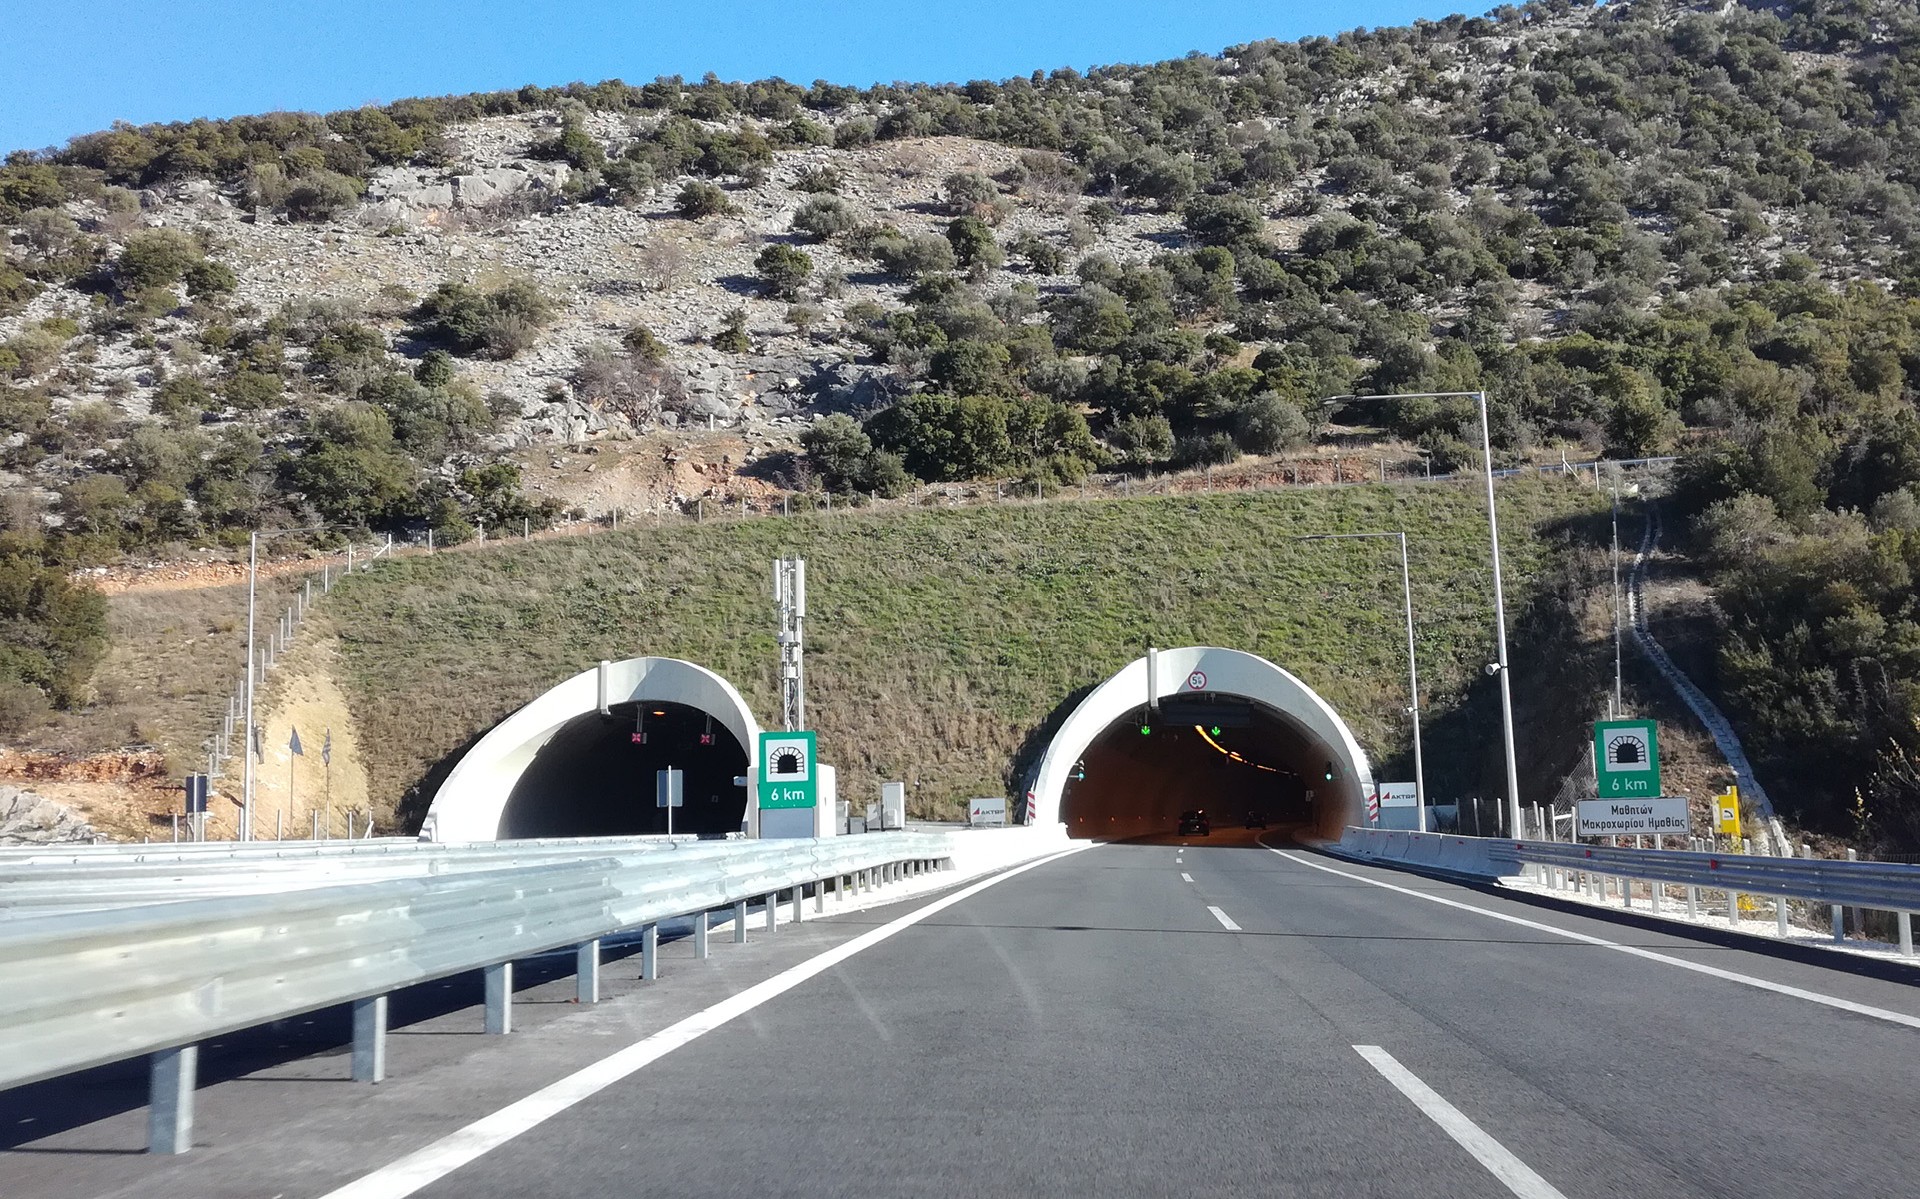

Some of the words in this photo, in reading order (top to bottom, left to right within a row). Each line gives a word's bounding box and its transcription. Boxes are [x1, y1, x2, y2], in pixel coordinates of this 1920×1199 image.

[1611, 778, 1620, 791] 6
[1624, 778, 1648, 790] km
[771, 788, 779, 801] 6
[783, 787, 805, 801] km
[1611, 804, 1653, 815] Μαθητών
[1582, 817, 1644, 831] Μακροχωρίου
[1648, 816, 1685, 830] Ημαθίας
